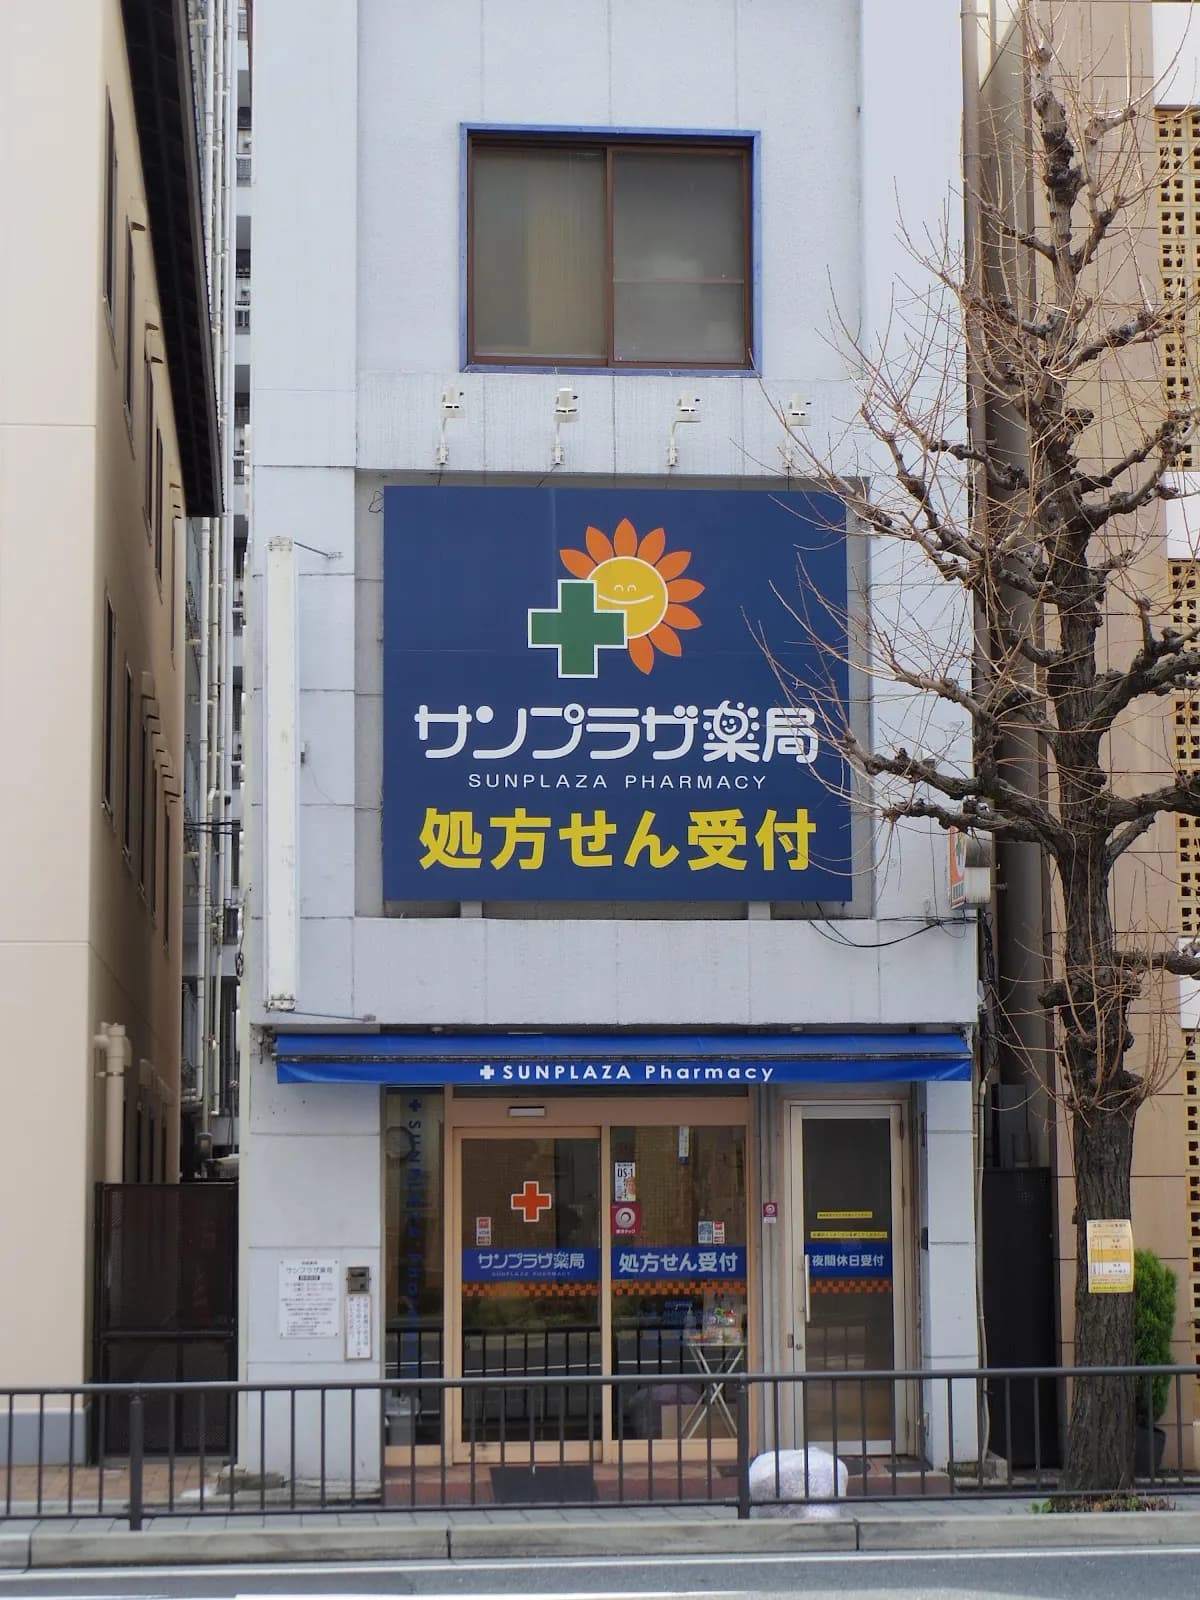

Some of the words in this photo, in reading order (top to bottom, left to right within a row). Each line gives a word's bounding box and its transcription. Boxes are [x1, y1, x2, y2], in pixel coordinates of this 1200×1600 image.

[414, 700, 819, 763] サンプラザ薬局
[468, 774, 607, 788] SUNPLAZA
[625, 775, 767, 790] PHARMACY
[418, 807, 817, 871] 処方せん受付
[503, 1065, 631, 1080] SUNPLAZA
[645, 1065, 774, 1082] Pharmacy
[478, 1251, 585, 1269] サンプラザ薬局
[618, 1252, 738, 1273] 処方せん受付
[812, 1254, 884, 1267] 夜間休日受付
